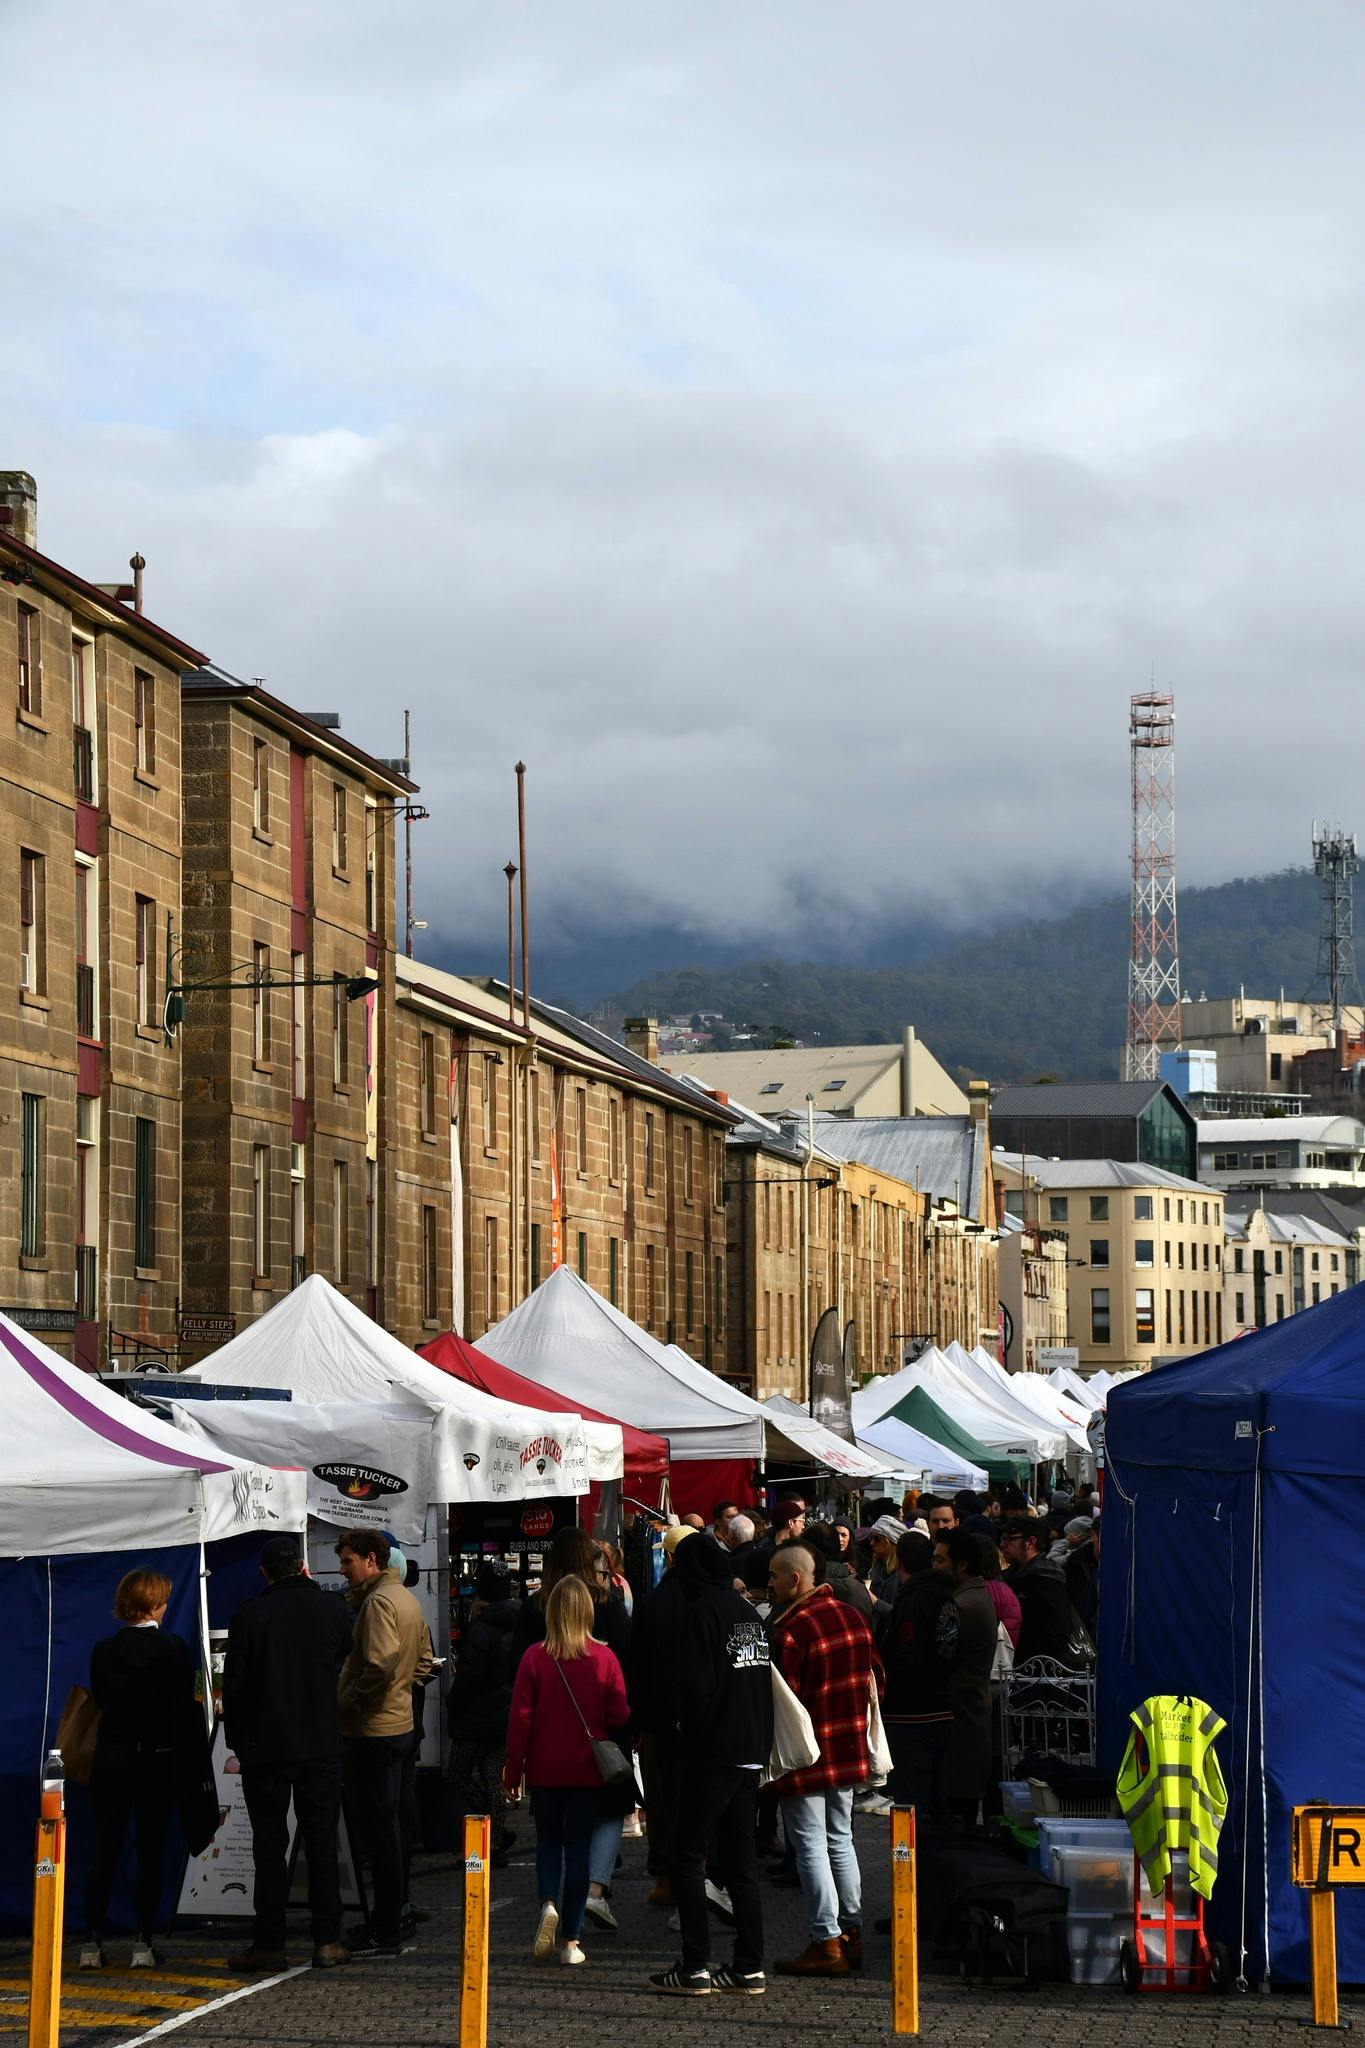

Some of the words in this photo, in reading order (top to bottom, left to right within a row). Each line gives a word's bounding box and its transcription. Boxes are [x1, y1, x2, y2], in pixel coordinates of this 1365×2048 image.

[53, 1313, 75, 1327] CENTRE
[183, 1320, 207, 1329] KELLY
[210, 1320, 233, 1330] STEPS
[519, 1436, 542, 1471] TASSIE
[542, 1435, 562, 1469] TUCKER
[318, 1465, 356, 1478] TASSIE
[358, 1468, 401, 1490] TUCKER
[338, 1505, 364, 1514] TASMANIA
[343, 1500, 360, 1508] CHILLI
[360, 1502, 389, 1512] PRODUCTS
[524, 1522, 550, 1531] LARGE
[510, 1541, 526, 1552] RUBS
[527, 1541, 540, 1551] AND
[1160, 1711, 1193, 1724] Market
[1160, 1731, 1193, 1744] tallholder
[1333, 1828, 1361, 1867] R
